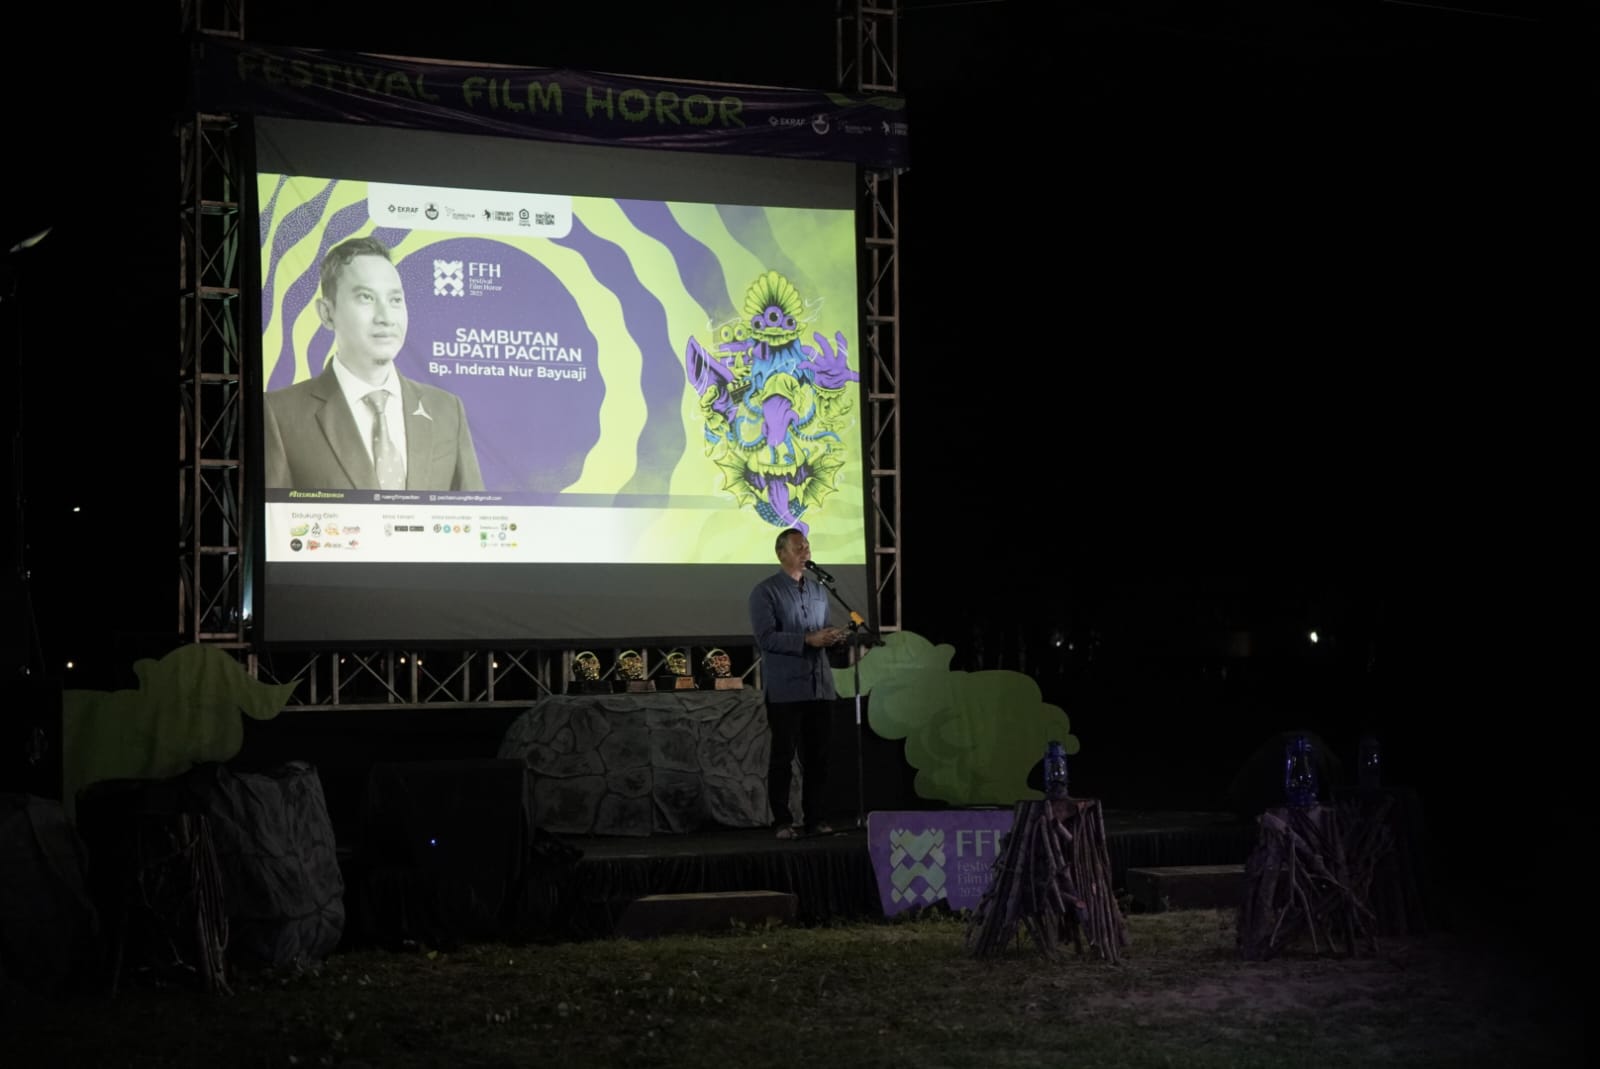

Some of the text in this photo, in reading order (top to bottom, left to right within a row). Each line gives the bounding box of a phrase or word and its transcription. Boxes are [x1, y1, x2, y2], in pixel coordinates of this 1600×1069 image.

[236, 51, 746, 128] FESTIVAL FILM HOROR
[779, 116, 806, 127] EKRAF
[397, 206, 419, 214] EKRAF
[468, 262, 501, 279] FFH
[468, 283, 483, 291] Film
[455, 327, 559, 347] SAMBUTAN
[432, 341, 582, 362] BUPATI PACITAN
[428, 361, 587, 382] Bp. Indrata Nur Bayuaji
[957, 872, 982, 885] Film
